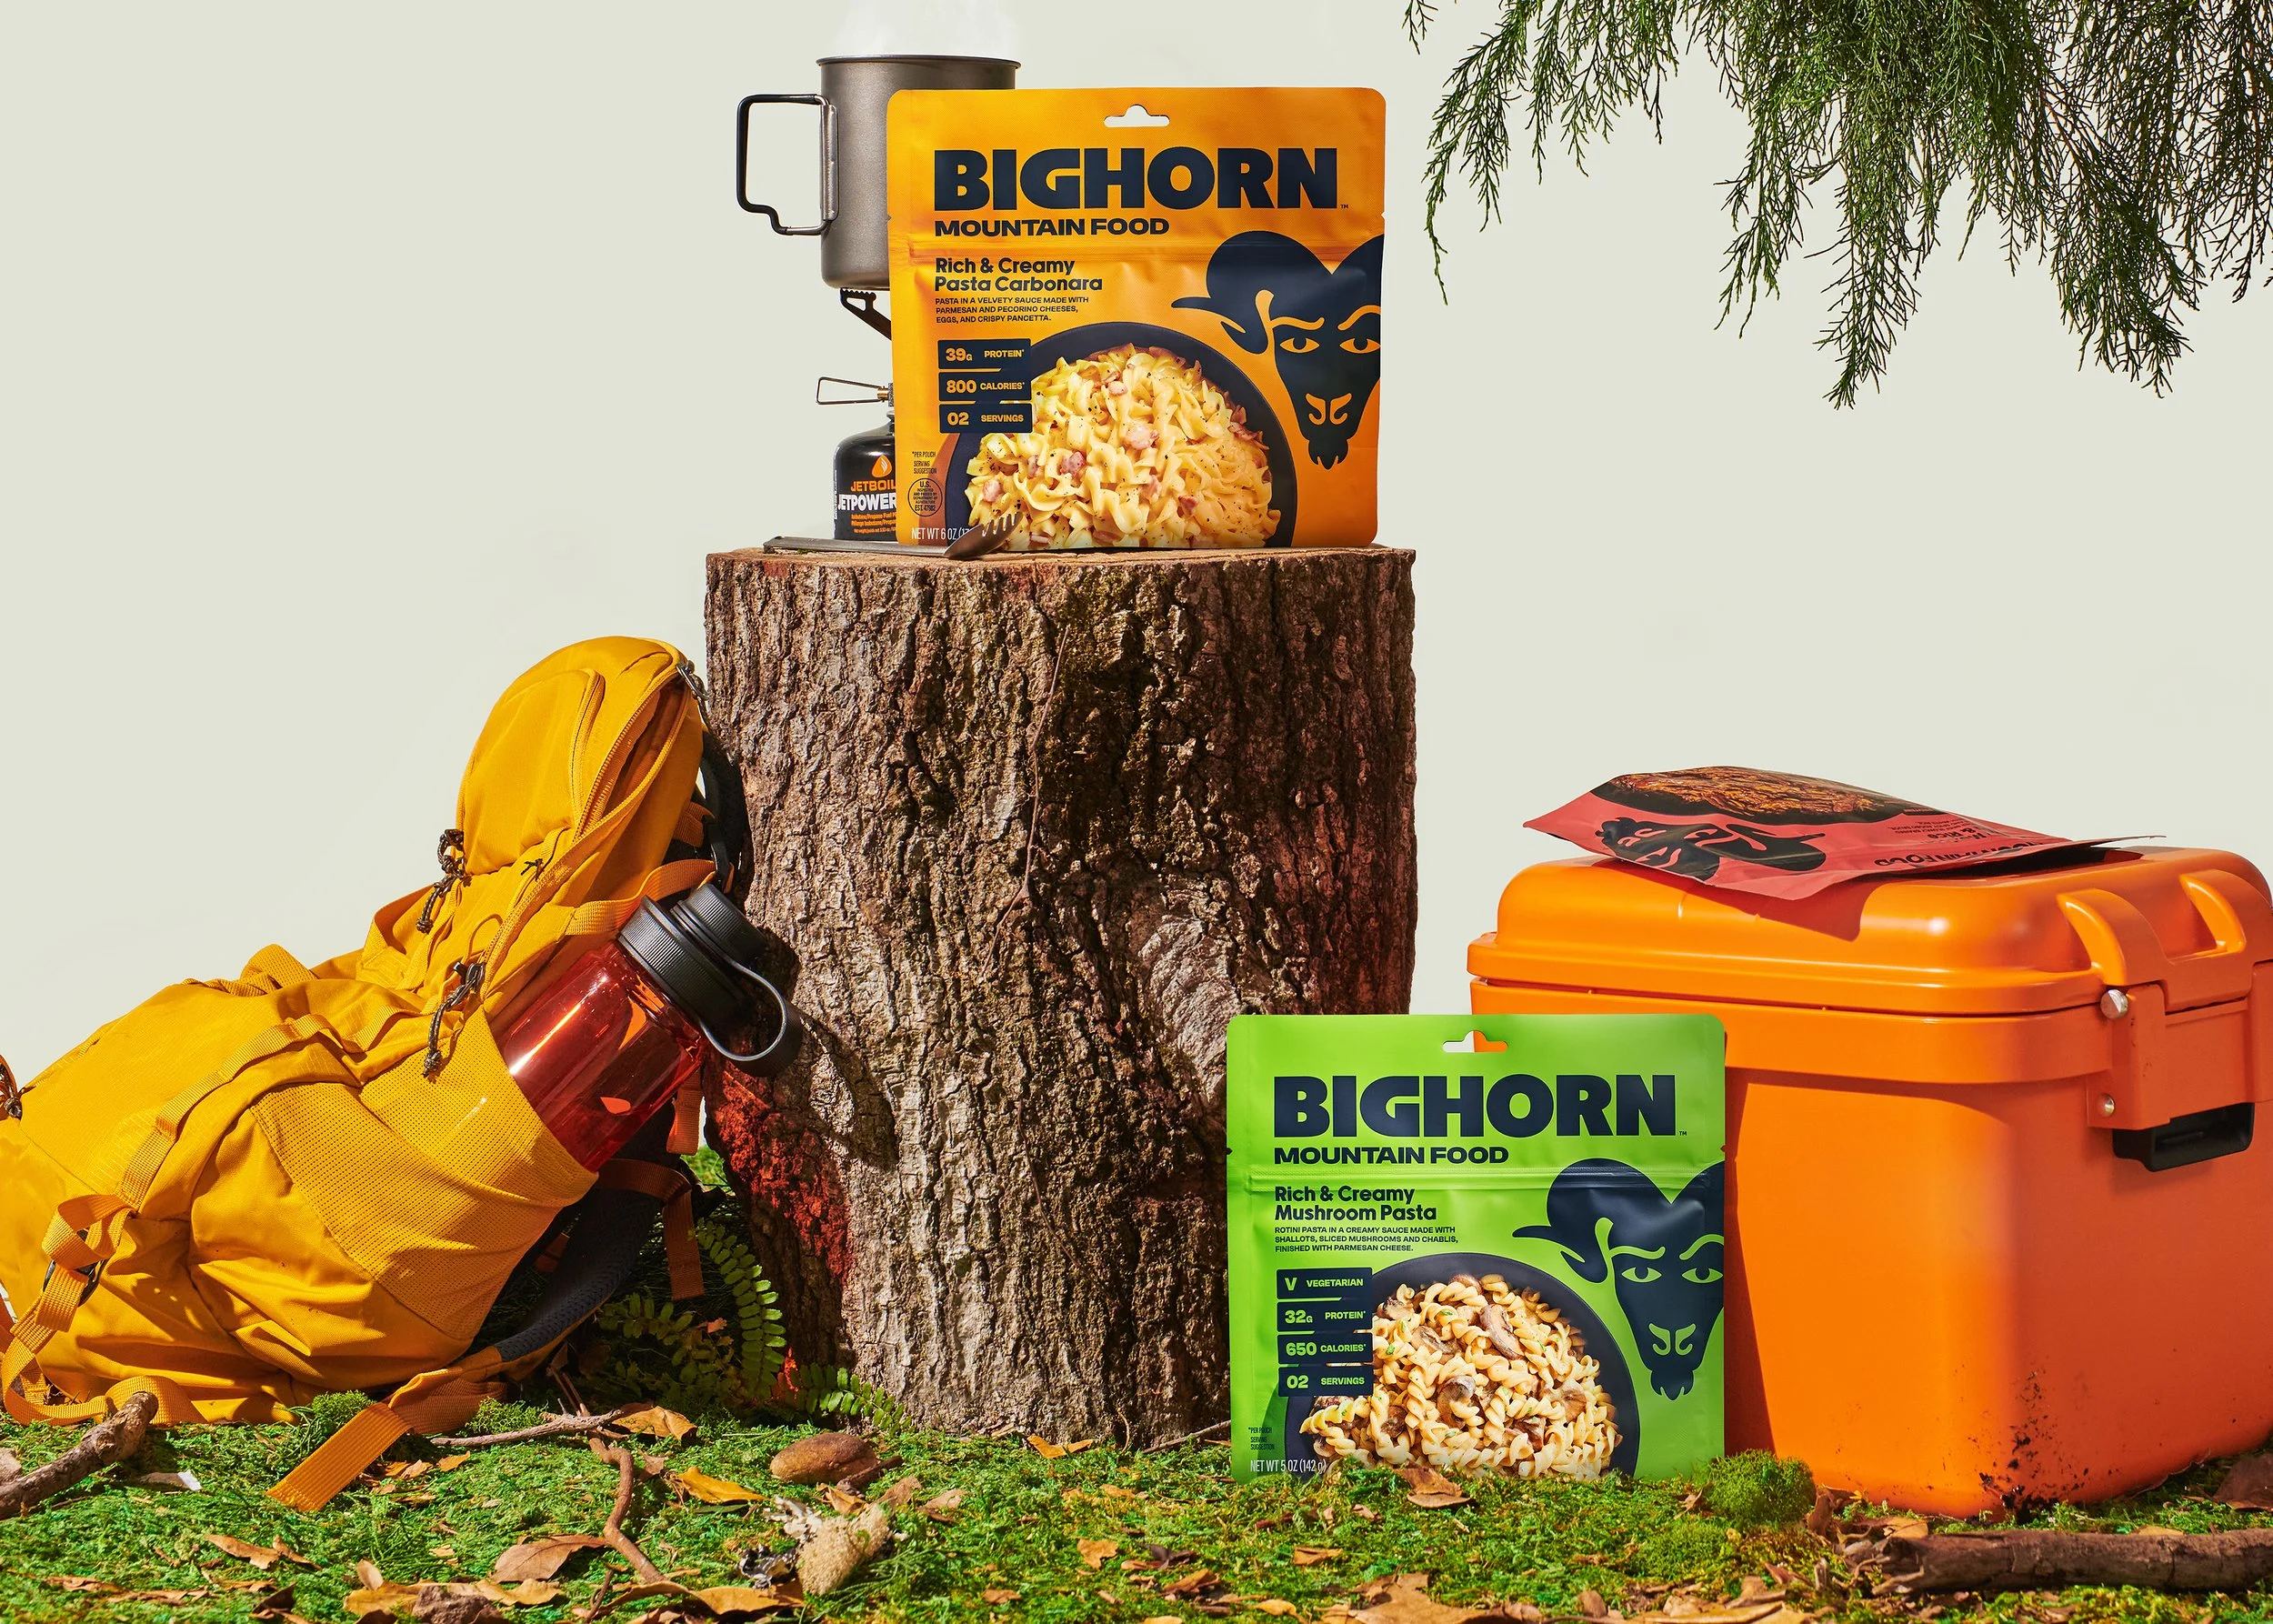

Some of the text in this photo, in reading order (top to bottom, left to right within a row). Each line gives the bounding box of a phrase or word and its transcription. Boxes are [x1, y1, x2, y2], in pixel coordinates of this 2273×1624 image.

[935, 146, 1337, 211] BIGHORN
[935, 217, 1170, 236] MOUNTAIN FOOD
[936, 257, 1075, 276] Rich & Creamy
[935, 276, 1103, 292] Pasta Carbonara
[946, 379, 976, 394] 800
[947, 412, 1024, 426] 02 SERVINGS
[850, 479, 896, 492] JETBOIL
[837, 492, 896, 511] JETPOWER
[911, 527, 926, 540] NET
[926, 527, 939, 540] WT
[940, 527, 946, 539] 6
[947, 527, 957, 540] OZ
[1274, 1073, 1677, 1138] BIGHORN
[1274, 1146, 1509, 1165] MOUNTAIN FOOD
[1275, 1185, 1415, 1205] Rich & Creamy
[1275, 1204, 1437, 1220] Mushroom Pasta
[1275, 1236, 1317, 1244] SHALLOTS,
[1284, 1277, 1363, 1291] V VEGETARIAN
[1286, 1341, 1317, 1356] 650
[1287, 1374, 1365, 1388] 02 SERVINGS
[1250, 1459, 1265, 1472] NET
[1266, 1459, 1279, 1472] WT
[1280, 1459, 1287, 1471] 5
[1287, 1459, 1298, 1472] OZ
[1299, 1459, 1317, 1473] (142
